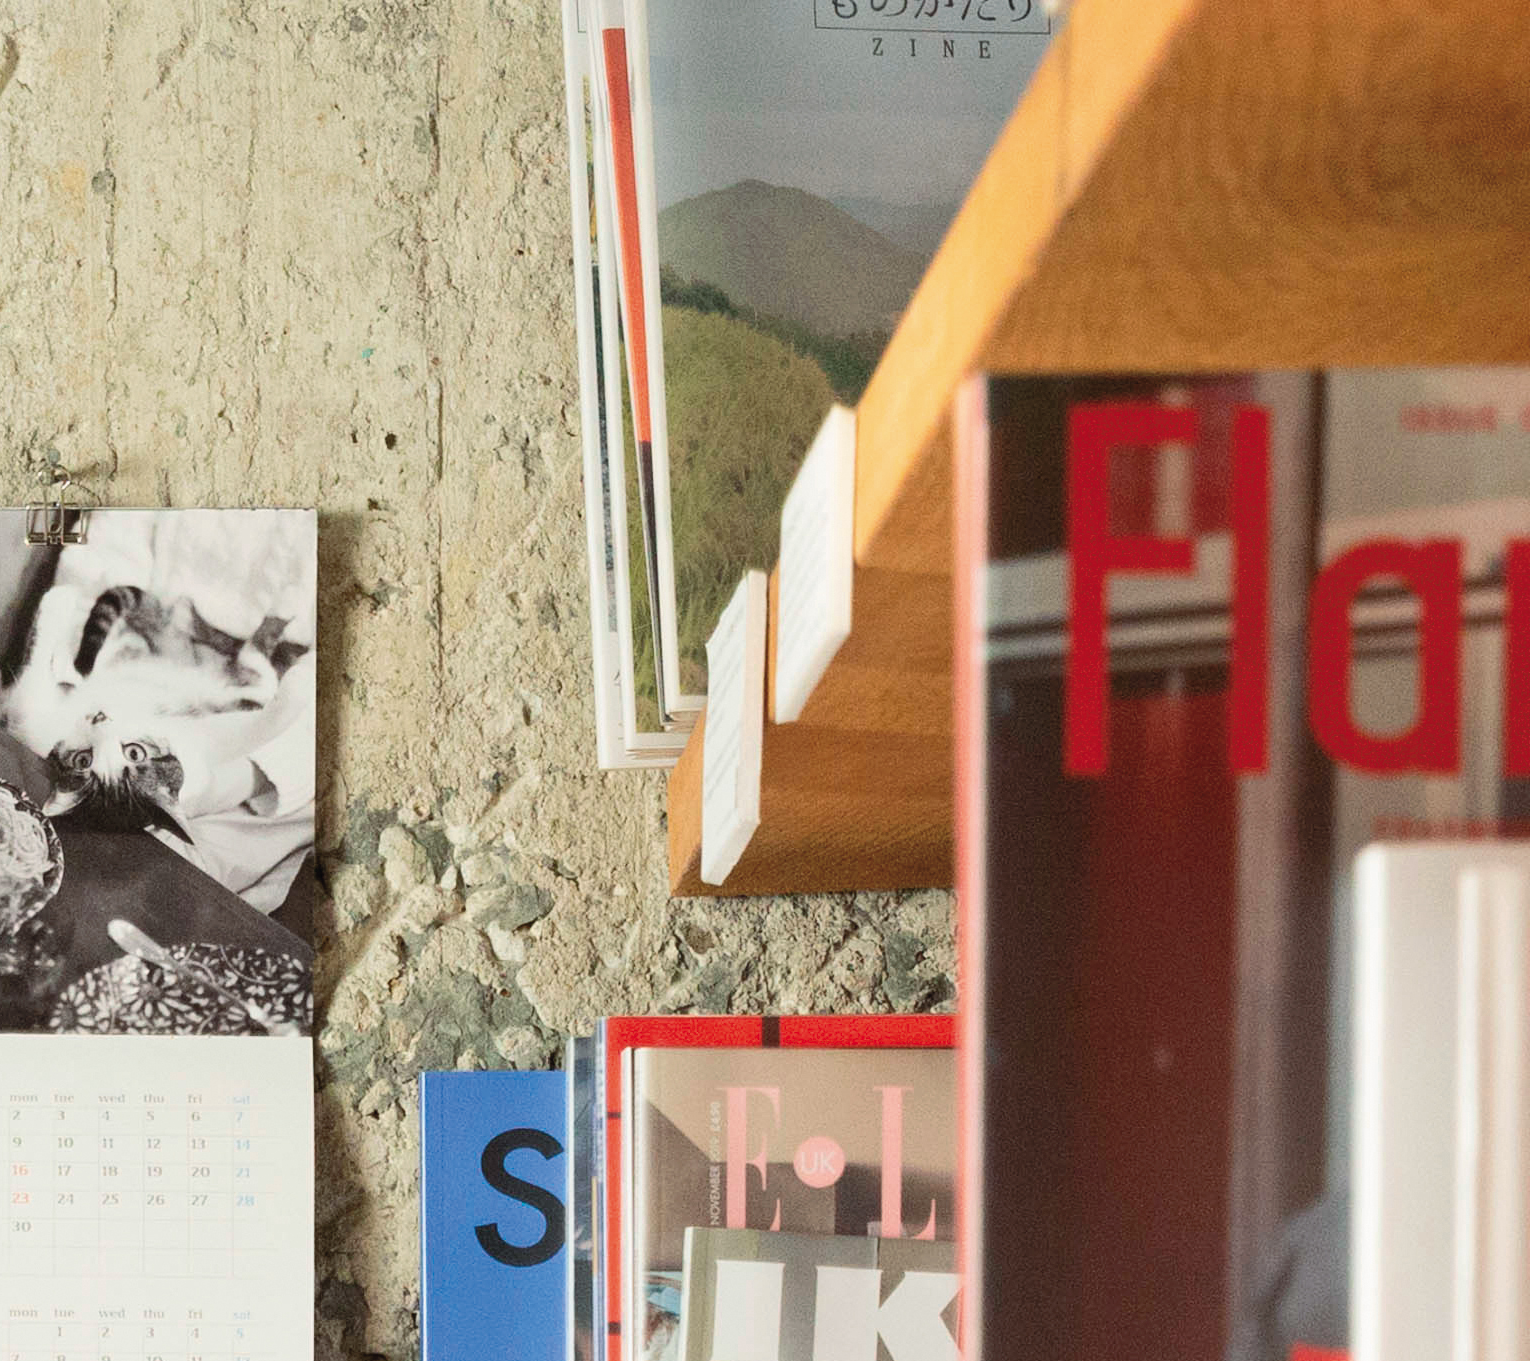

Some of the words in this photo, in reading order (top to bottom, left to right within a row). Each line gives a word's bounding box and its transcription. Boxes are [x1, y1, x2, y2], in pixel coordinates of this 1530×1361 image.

[872, 37, 992, 59] ZINE
[10, 1095, 39, 1103] mon
[53, 1094, 75, 1103] tue
[98, 1094, 126, 1104] wed
[143, 1094, 164, 1104] thu
[187, 1094, 203, 1104] fri
[11, 1111, 21, 1121] 2
[57, 1111, 66, 1121] 3
[101, 1111, 110, 1121] 4
[146, 1111, 155, 1121] 5
[191, 1112, 201, 1121] 6
[12, 1137, 23, 1147] 9
[57, 1138, 74, 1148] 10
[101, 1138, 114, 1149] 11
[146, 1138, 162, 1149] 12
[190, 1139, 207, 1150] 13
[798, 1151, 837, 1176] UK
[11, 1165, 28, 1176] 16
[57, 1165, 72, 1176] 17
[101, 1166, 118, 1177] 18
[146, 1167, 163, 1177] 19
[190, 1167, 211, 1178] 20
[11, 1193, 30, 1205] 23
[57, 1194, 75, 1205] 24
[101, 1194, 119, 1205] 25
[146, 1195, 165, 1206] 26
[190, 1195, 209, 1207] 27
[474, 1127, 567, 1268] S
[709, 1165, 721, 1225] NOVEMBER
[11, 1222, 32, 1233] 30
[9, 1310, 39, 1318] mon
[53, 1309, 75, 1318] tue
[98, 1309, 126, 1319] wed
[143, 1309, 165, 1319] thu
[101, 1327, 110, 1338] 2
[147, 1328, 155, 1338] 3
[190, 1328, 200, 1339] 4
